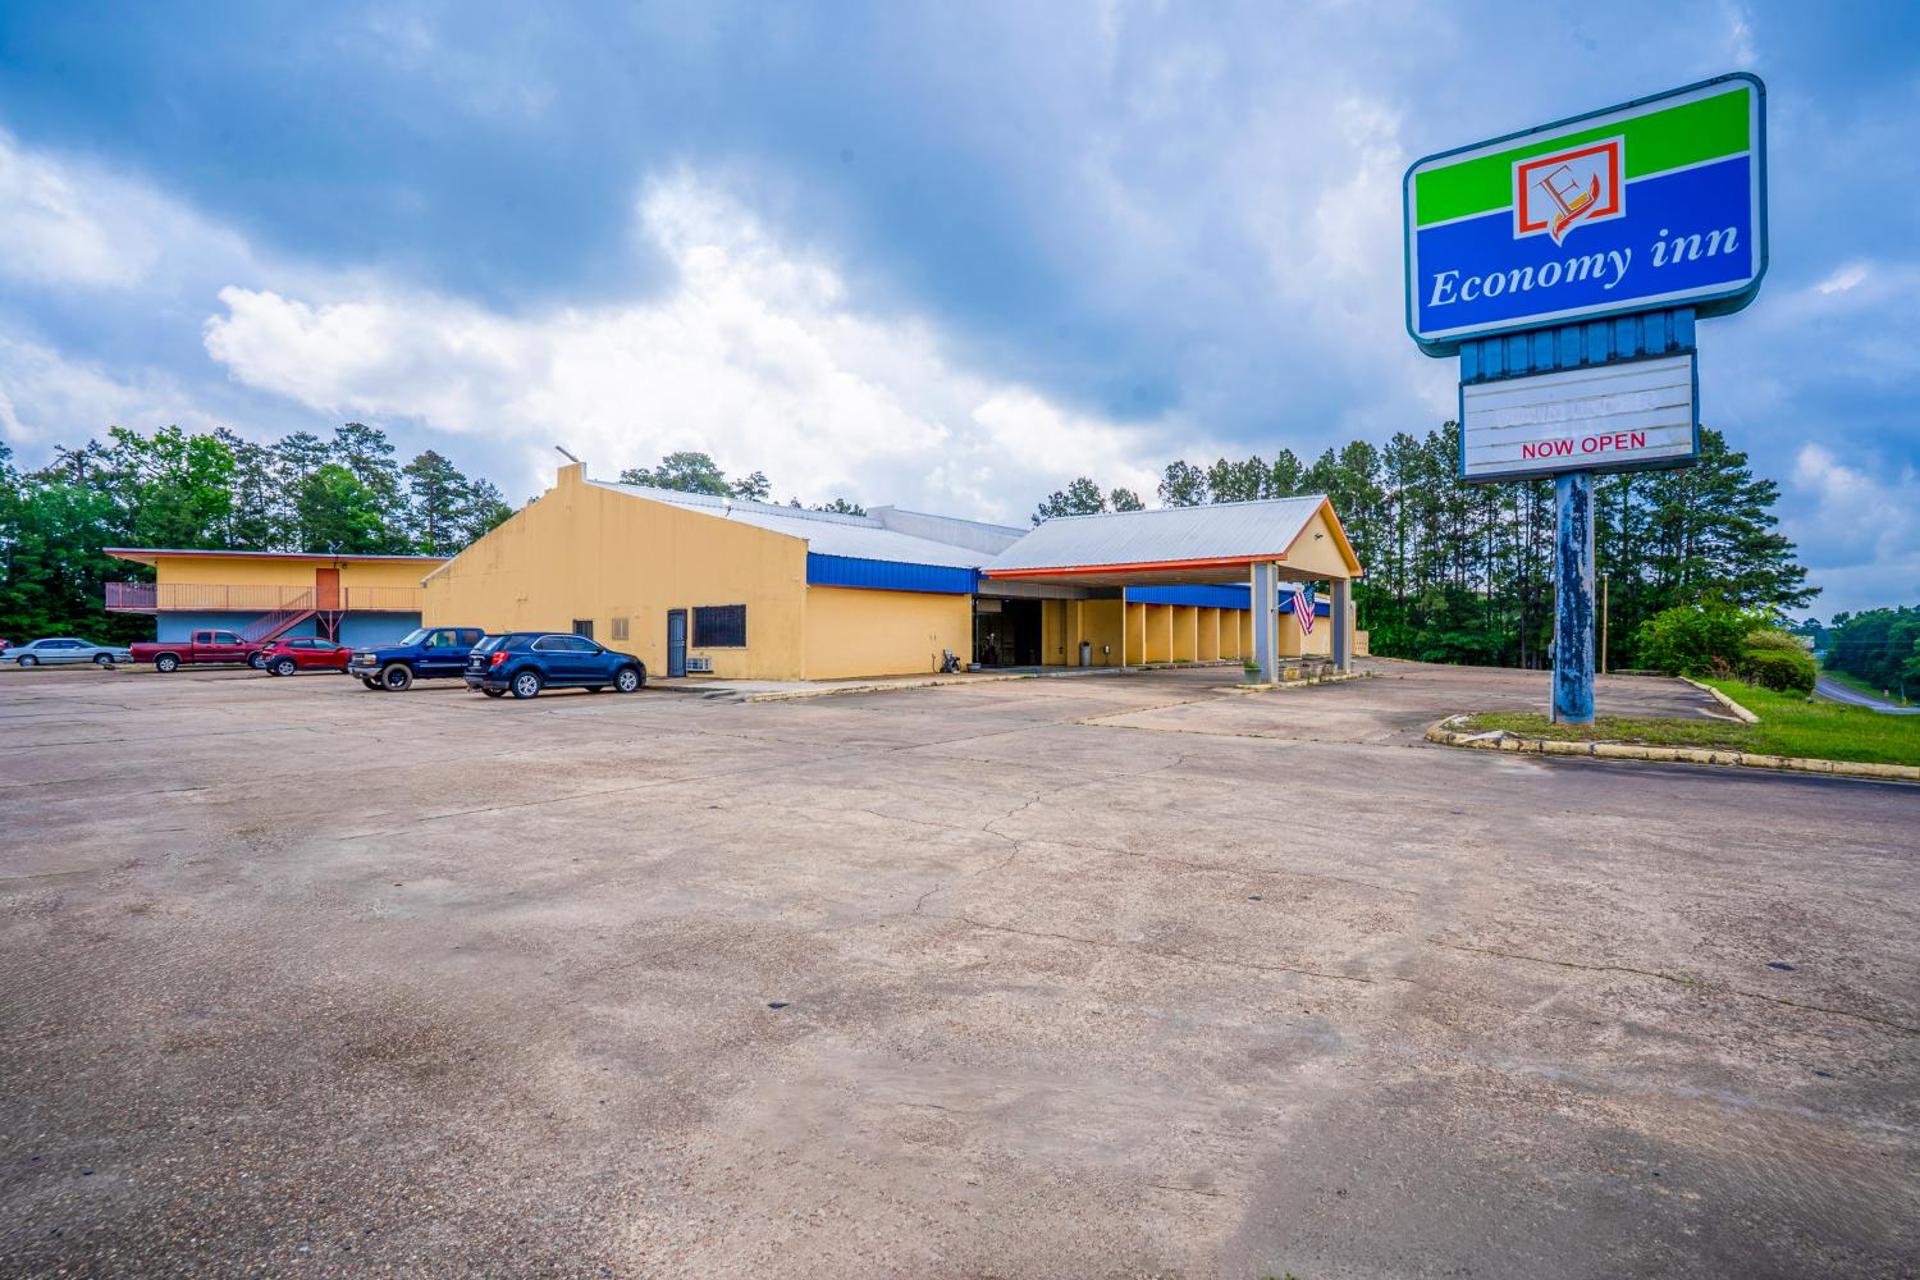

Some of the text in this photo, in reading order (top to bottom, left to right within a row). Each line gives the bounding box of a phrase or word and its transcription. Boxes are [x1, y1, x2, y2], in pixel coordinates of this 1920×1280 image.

[1429, 226, 1739, 307] Economy inn
[1522, 431, 1646, 460] NOW OPEN
